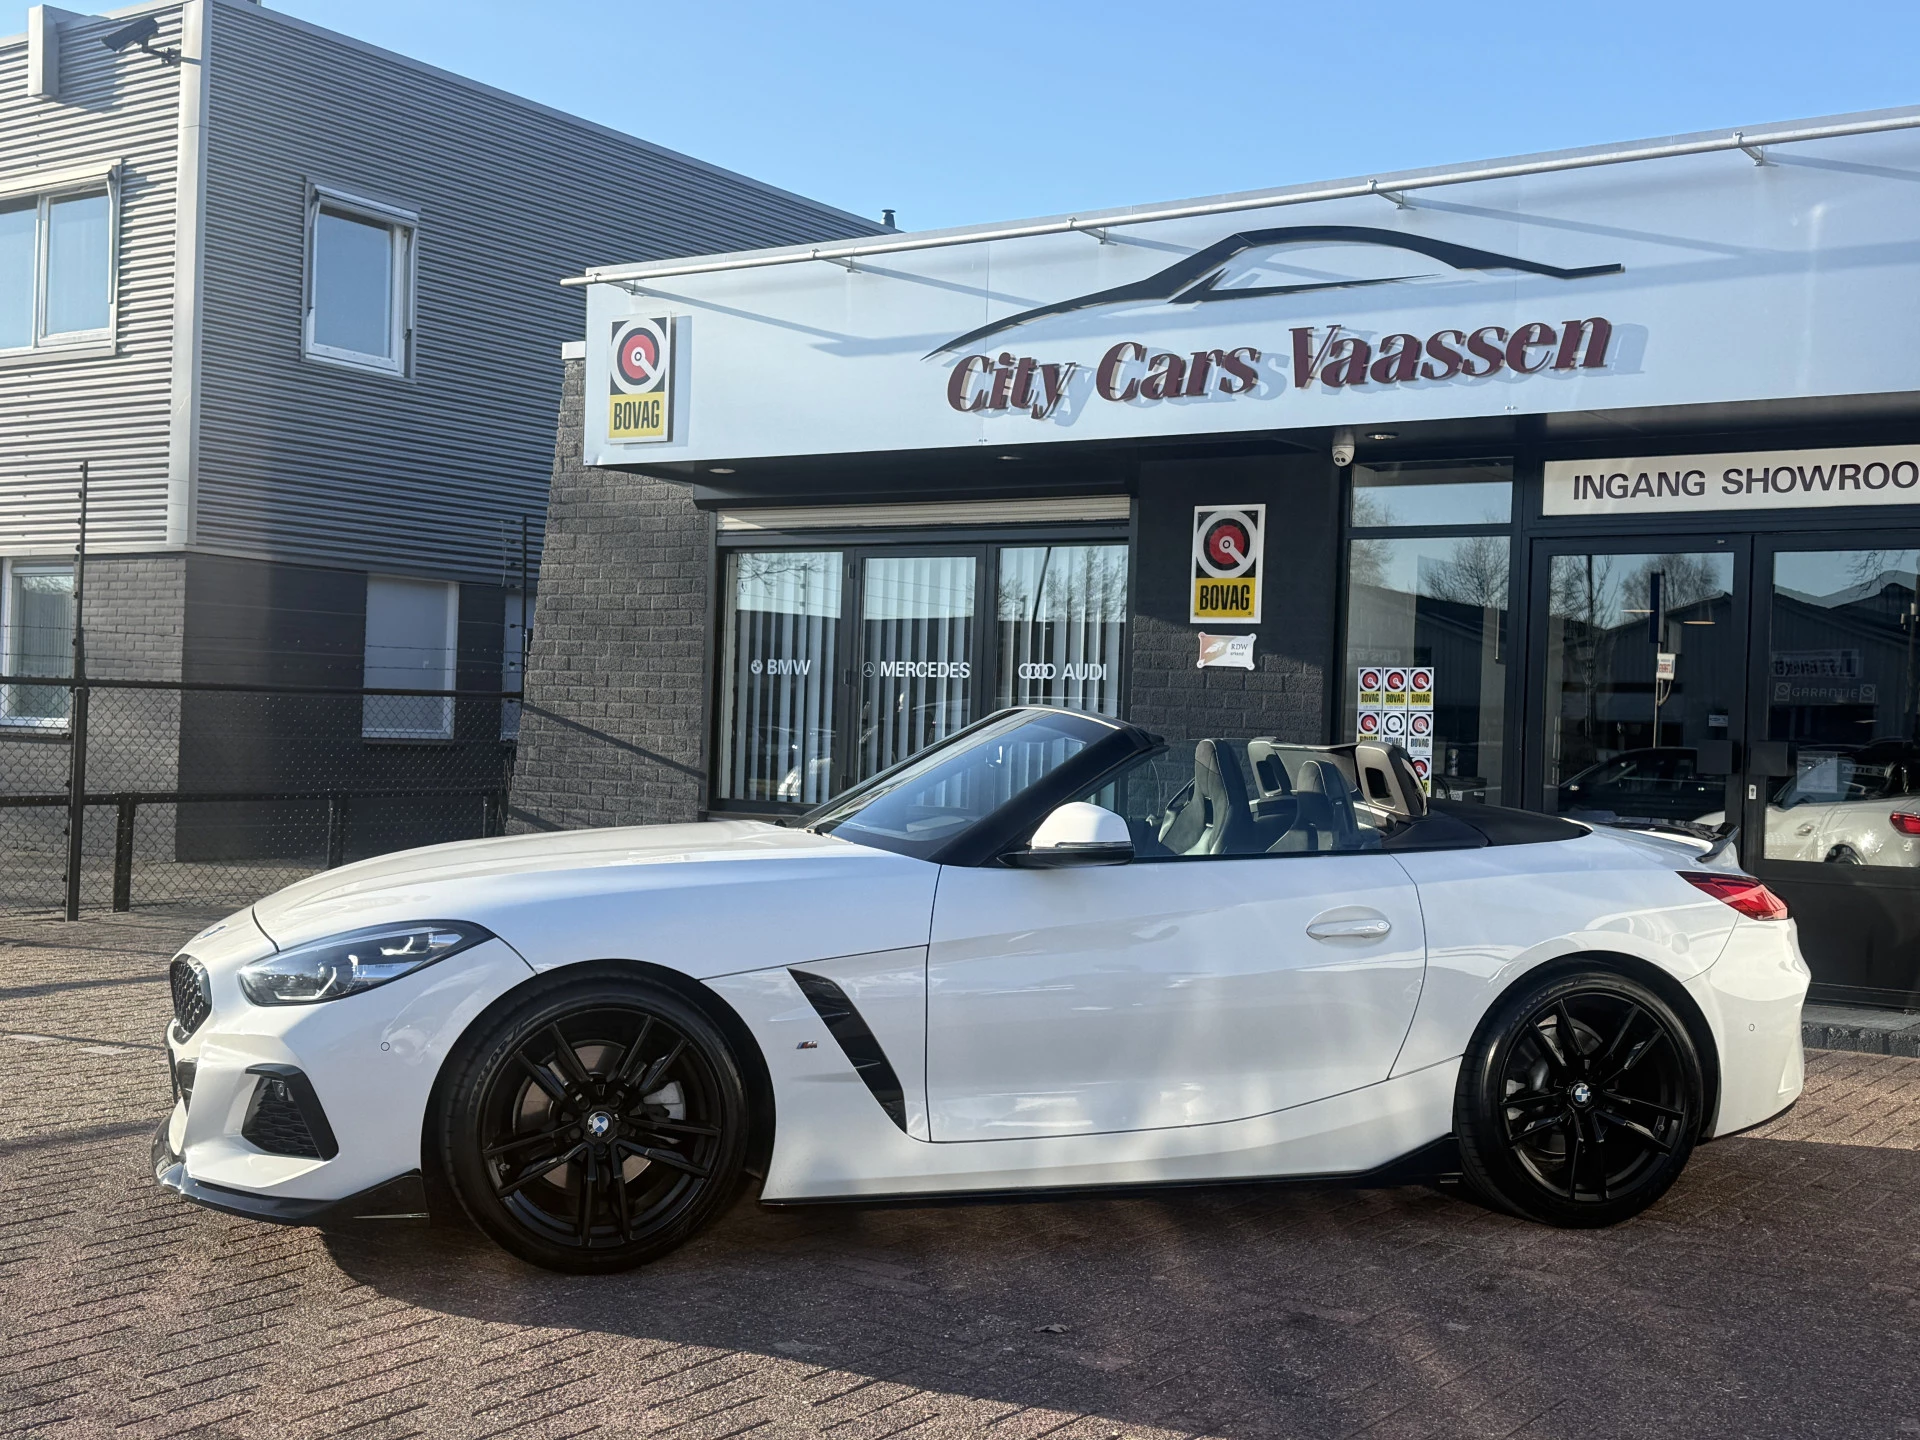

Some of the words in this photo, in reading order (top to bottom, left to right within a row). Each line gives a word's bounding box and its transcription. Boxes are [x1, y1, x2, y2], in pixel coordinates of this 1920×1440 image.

[946, 352, 1074, 420] City
[1096, 341, 1261, 402] Cars
[1288, 315, 1612, 390] Vaassen
[613, 399, 660, 431] BOVAG
[1573, 469, 1706, 500] INGANG
[1721, 460, 1920, 496] SHOWROO
[1199, 584, 1251, 611] BOVAG
[1230, 643, 1249, 651] RDW
[766, 659, 811, 676] BMW
[880, 661, 971, 679] MERCEDES
[1061, 662, 1108, 681] AUDI
[1791, 687, 1859, 698] GARANTIE
